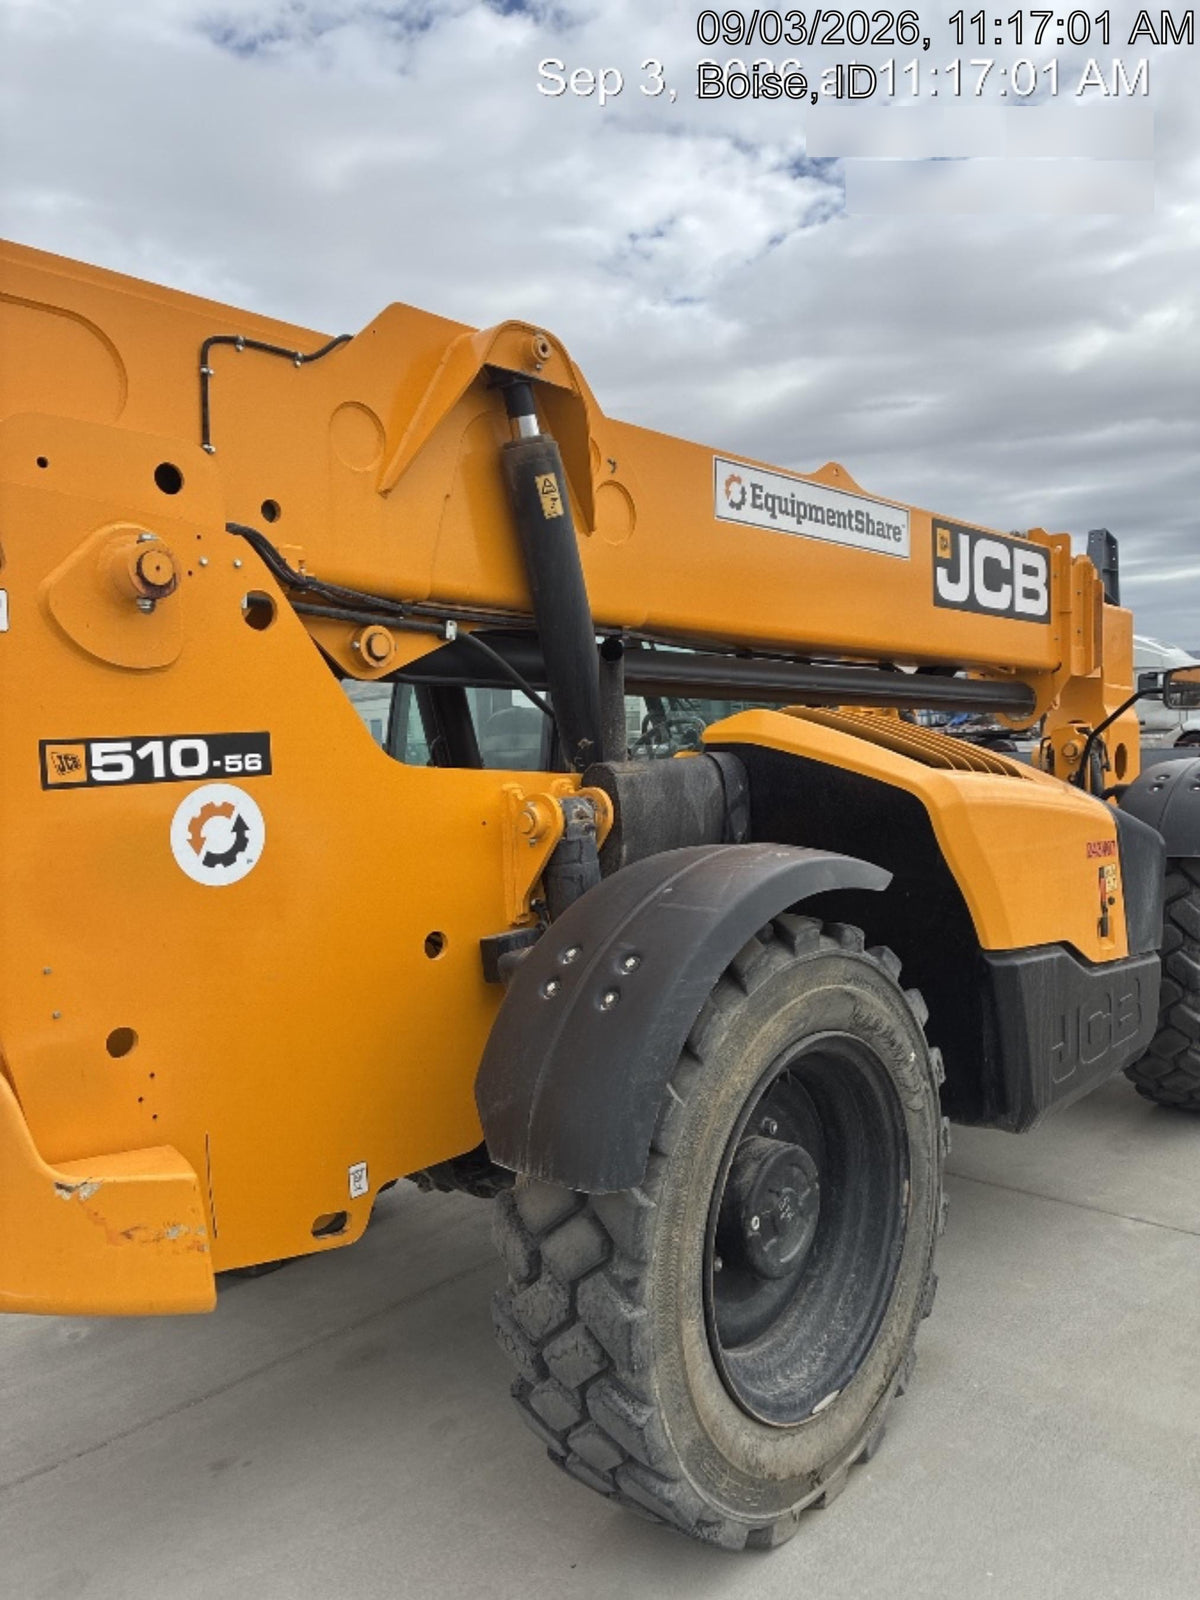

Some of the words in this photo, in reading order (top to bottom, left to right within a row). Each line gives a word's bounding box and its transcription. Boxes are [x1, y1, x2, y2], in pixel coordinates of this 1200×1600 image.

[749, 482, 902, 543] EquipmentShare
[936, 533, 1048, 617] JCB
[90, 738, 263, 781] 510-56
